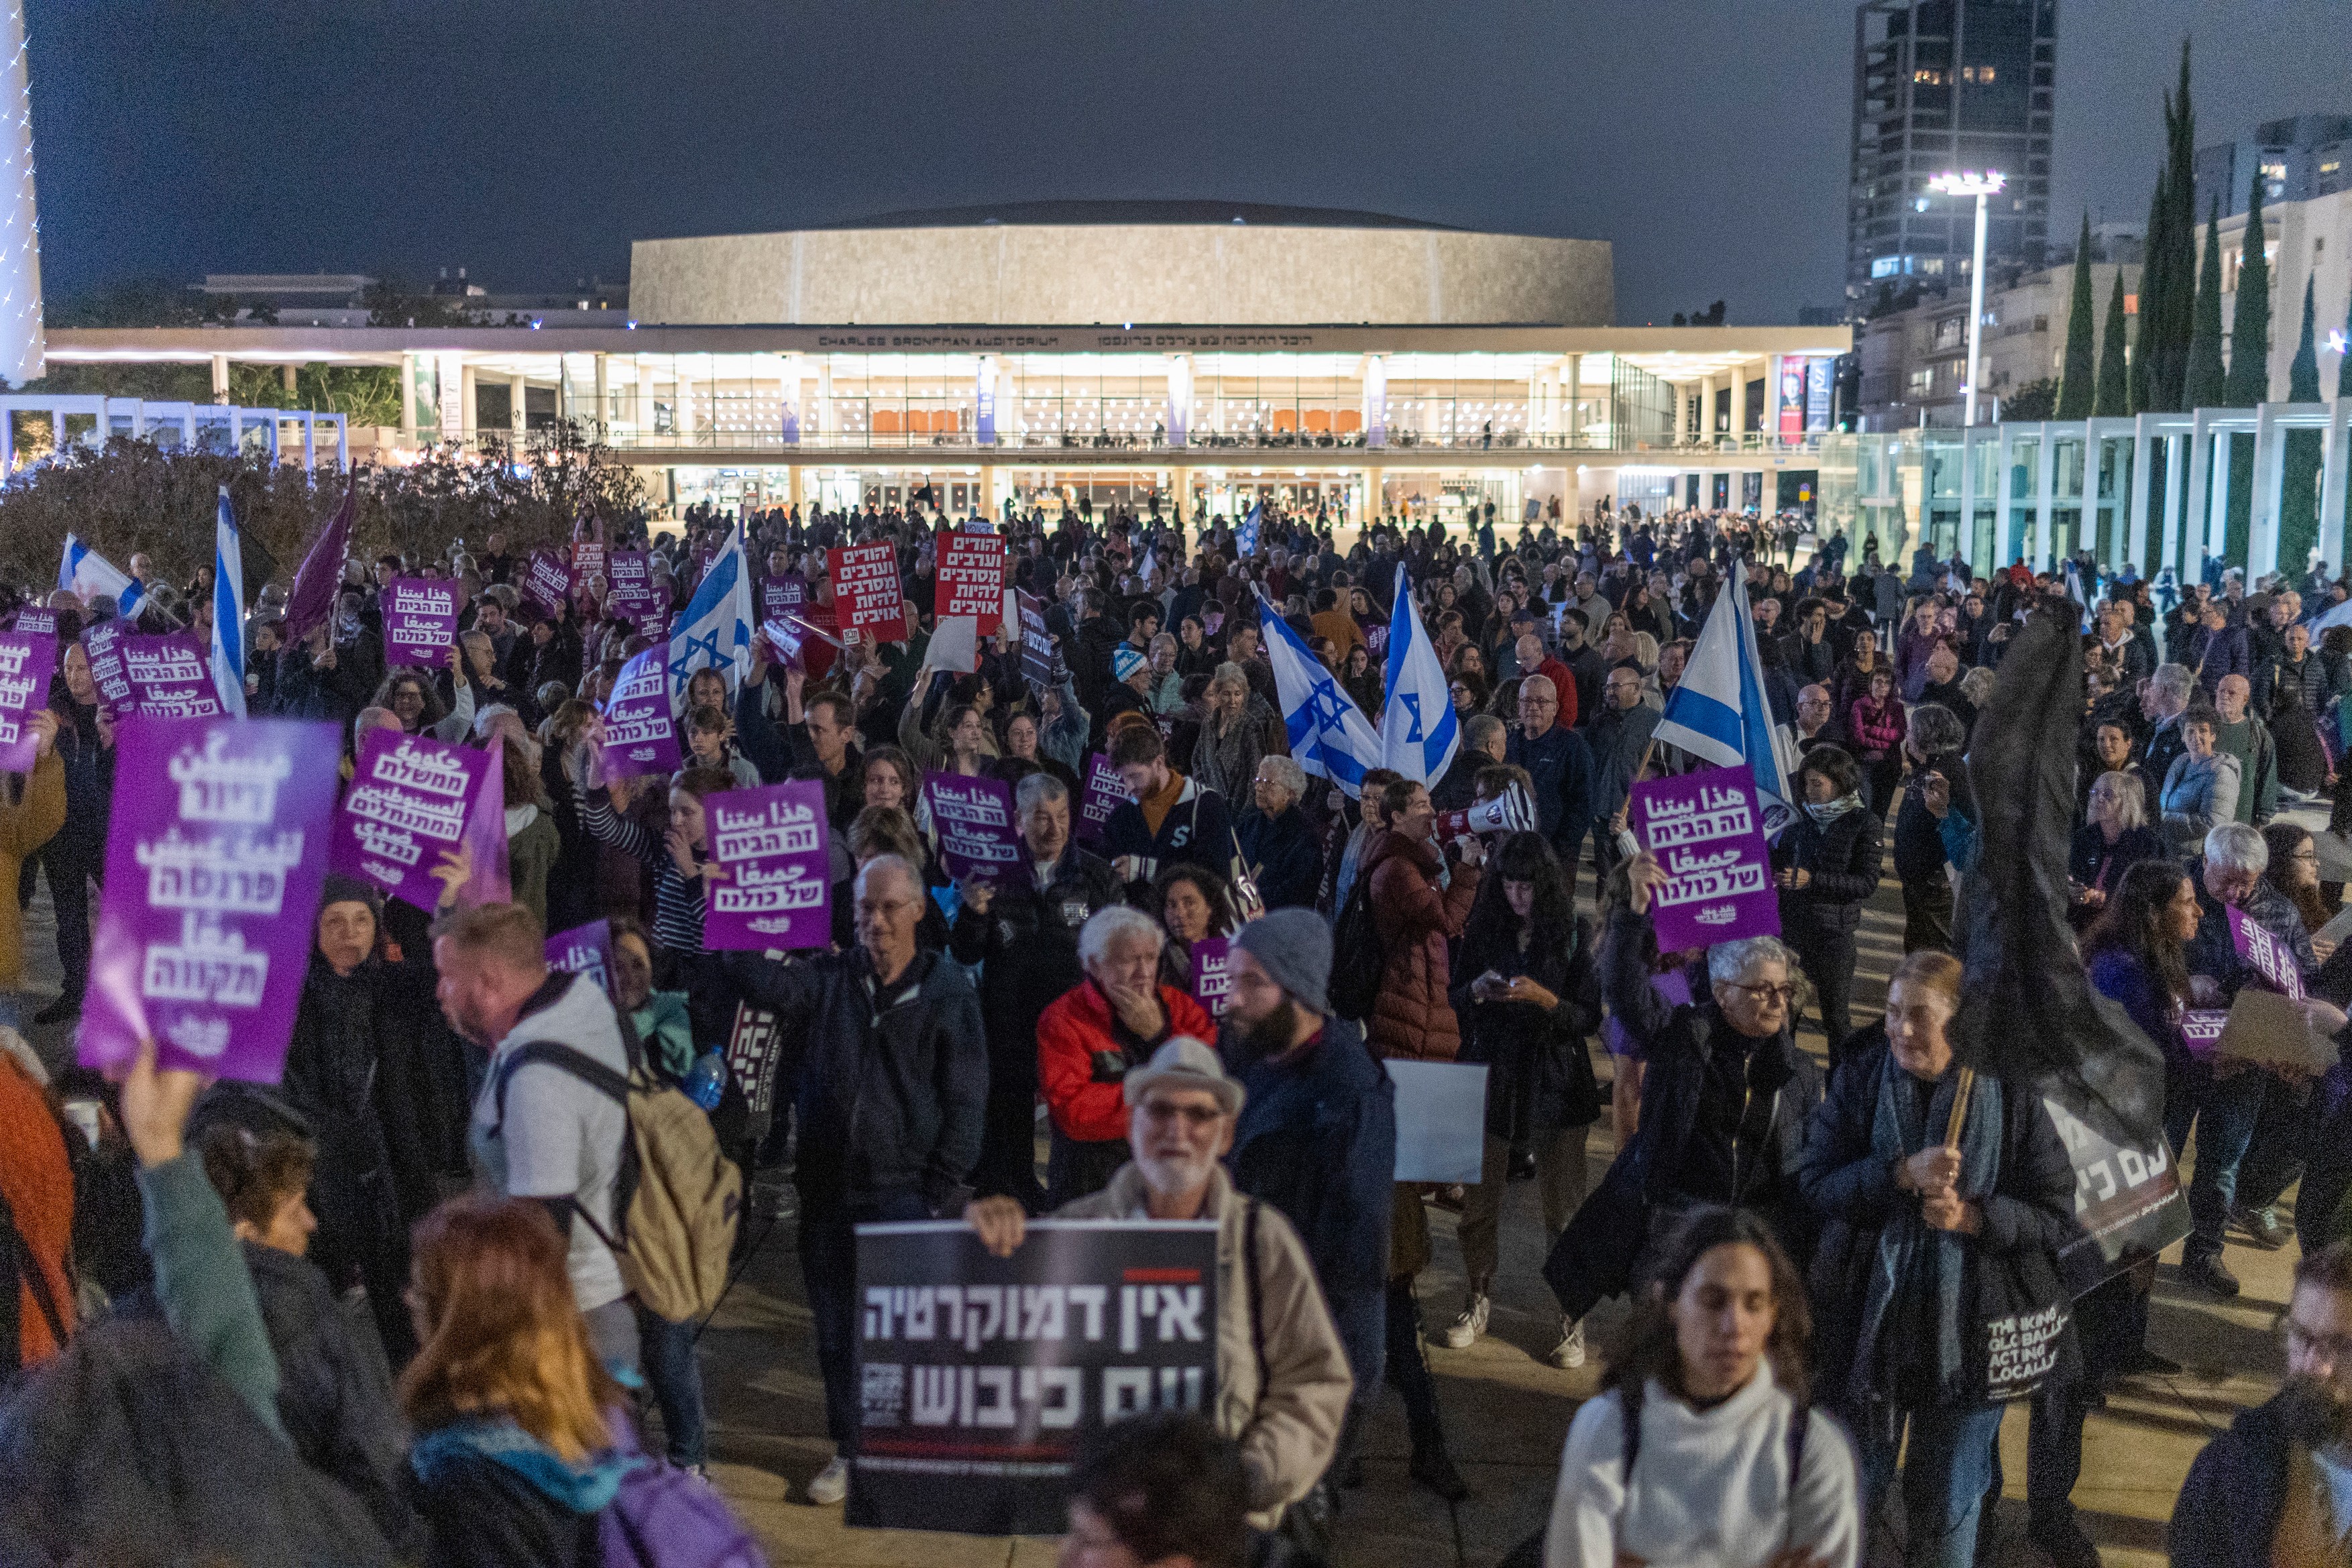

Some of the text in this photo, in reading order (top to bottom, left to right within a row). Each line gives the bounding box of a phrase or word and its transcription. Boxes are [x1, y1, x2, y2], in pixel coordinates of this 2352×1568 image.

[819, 336, 1059, 346] CHARLES BRONFMAN AUDITORIUM
[1098, 335, 1152, 347] ברונפמן
[1224, 335, 1276, 346] התרבות
[1280, 335, 1312, 346] היכל
[953, 537, 1001, 551] יהודים
[612, 558, 643, 567] هذا بيتنا
[842, 546, 890, 564] יהודים
[947, 553, 1001, 567] וערבים
[840, 561, 894, 580] וערבים
[940, 568, 1001, 583] מסרבים
[398, 585, 451, 601] هذا بيتنا
[618, 579, 642, 590] جميعًا
[637, 590, 649, 598] של
[836, 576, 897, 596] מסרבים
[956, 583, 1000, 598] להיות
[398, 602, 450, 613] זה הבית
[856, 590, 898, 609] להיות
[950, 600, 999, 614] אויבים
[404, 616, 443, 630] جميعًا
[852, 606, 901, 625] אויבים
[396, 630, 450, 642] של כולנו
[123, 647, 160, 663] بيتنا
[162, 647, 196, 661] هذا
[132, 665, 199, 679] זה הבית
[639, 661, 662, 677] هذا
[146, 683, 198, 702] جميعًا
[644, 679, 660, 693] זה
[185, 701, 213, 716] של
[612, 704, 655, 723] جميعًا
[606, 721, 667, 742] של כולנו
[396, 739, 463, 771] حكومة
[379, 759, 463, 792] ממשלת
[932, 782, 1003, 807] هذا بيتنا
[1093, 779, 1125, 795] הבית
[1644, 786, 1745, 820] هذا بيتنا
[353, 796, 459, 837] המתנחלים
[716, 802, 814, 832] هذا بيتنا
[940, 805, 1002, 823] זה הבית
[949, 821, 1001, 842] جميعًا
[1170, 824, 1190, 848] S
[1651, 812, 1746, 845] זה הבית
[373, 838, 416, 860] נגדי
[722, 829, 813, 856] זה הבית
[946, 839, 1013, 858] של כולנו
[1669, 847, 1742, 875] جميعًا
[736, 861, 806, 888] جميعًا
[1657, 865, 1759, 901] של כולנו
[159, 867, 278, 903] פרנסה
[720, 882, 818, 906] של כולנו
[153, 955, 260, 1001] תקווה
[864, 1284, 1203, 1353] אין דמוקרטיה
[1989, 1343, 2046, 1368] ACTING
[1989, 1350, 2056, 1384] LOCALLY
[911, 1364, 1084, 1428] כיבוש
